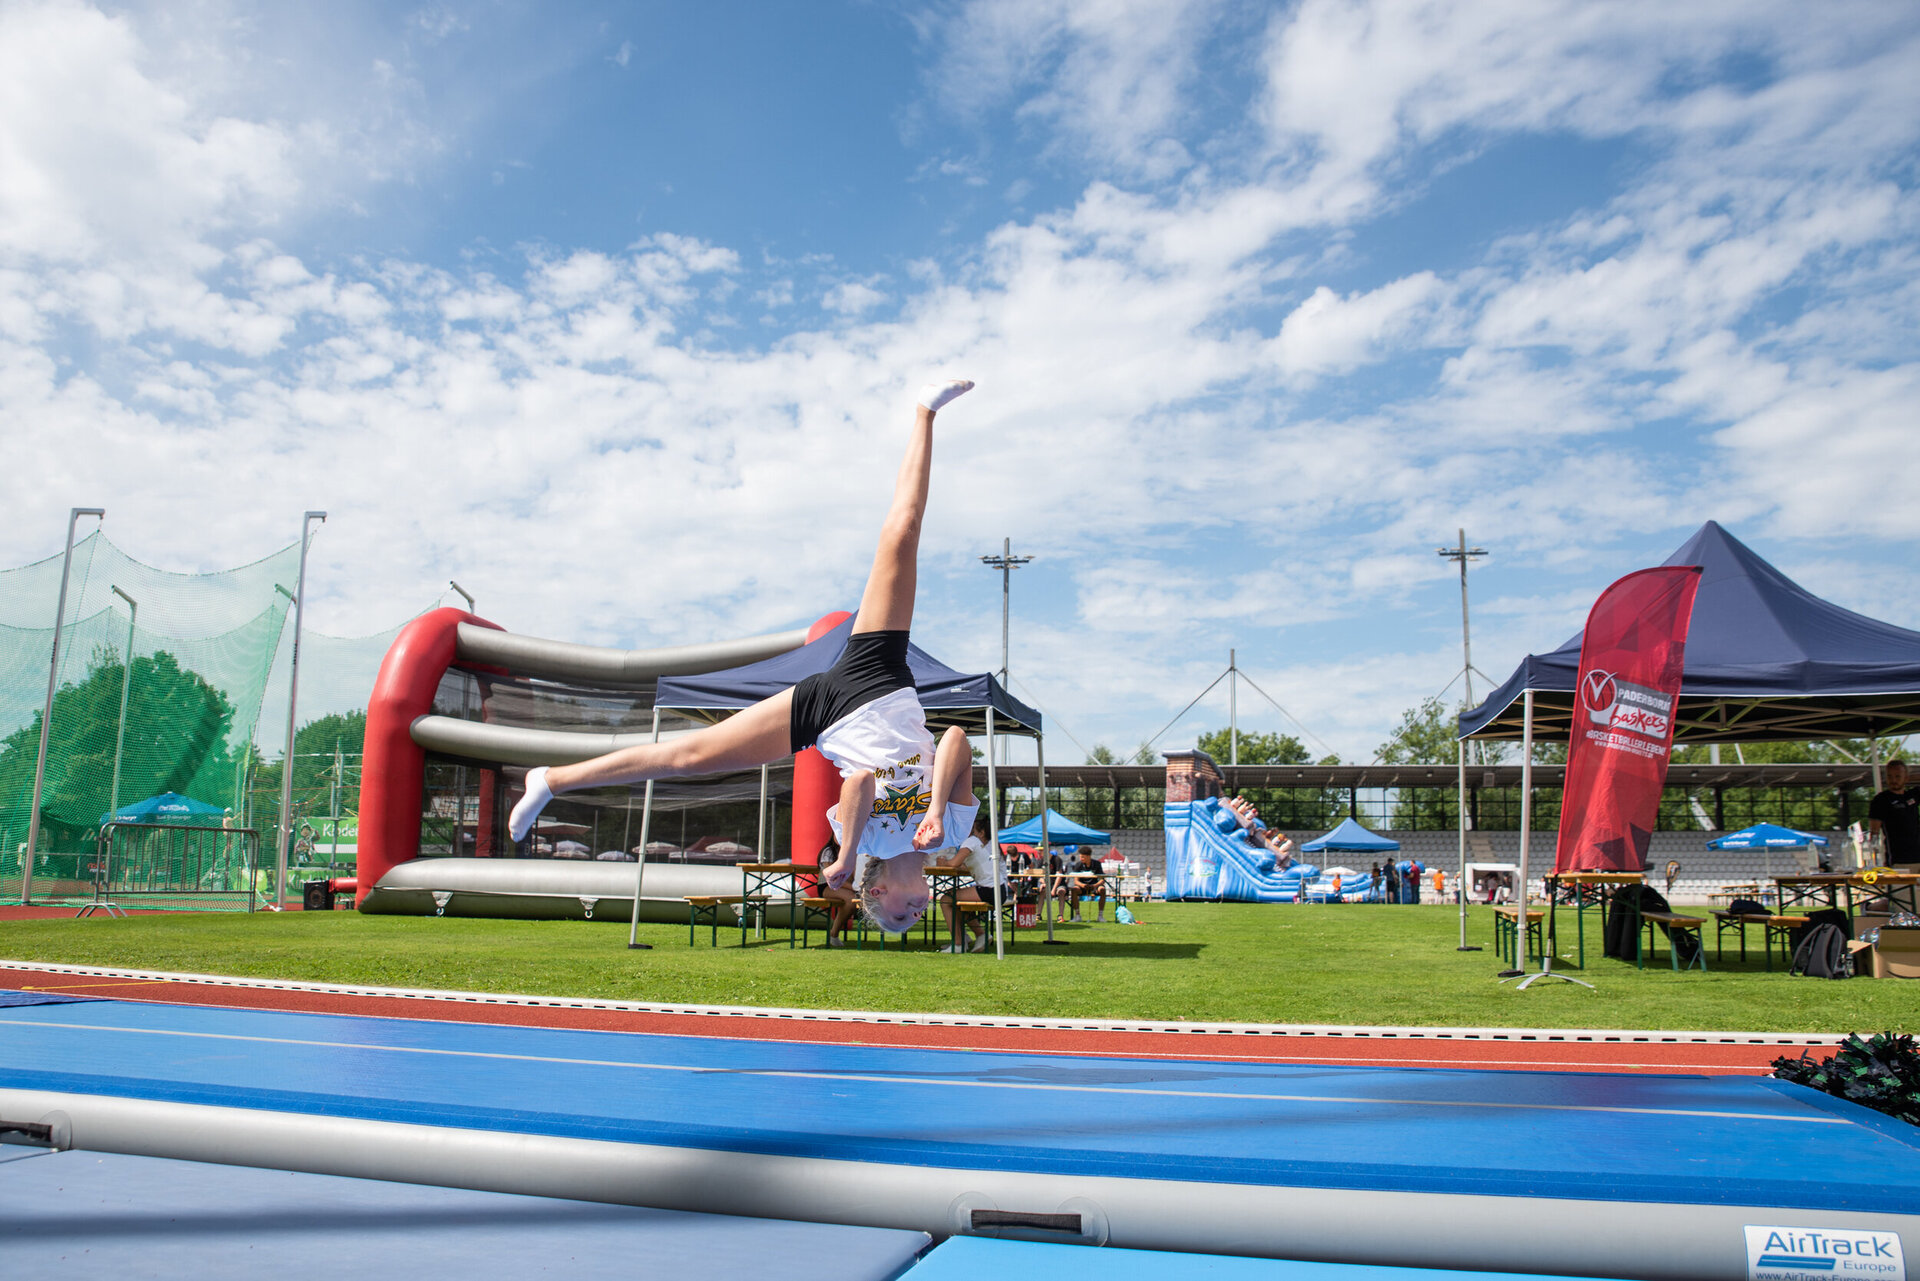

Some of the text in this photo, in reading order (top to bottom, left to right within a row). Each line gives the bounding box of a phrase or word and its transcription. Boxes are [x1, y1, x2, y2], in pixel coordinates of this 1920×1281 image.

[1617, 688, 1671, 712] PADERBORN
[873, 791, 932, 814] Stars
[1764, 1231, 1895, 1258] AirTrack
[1843, 1260, 1897, 1273] Europe
